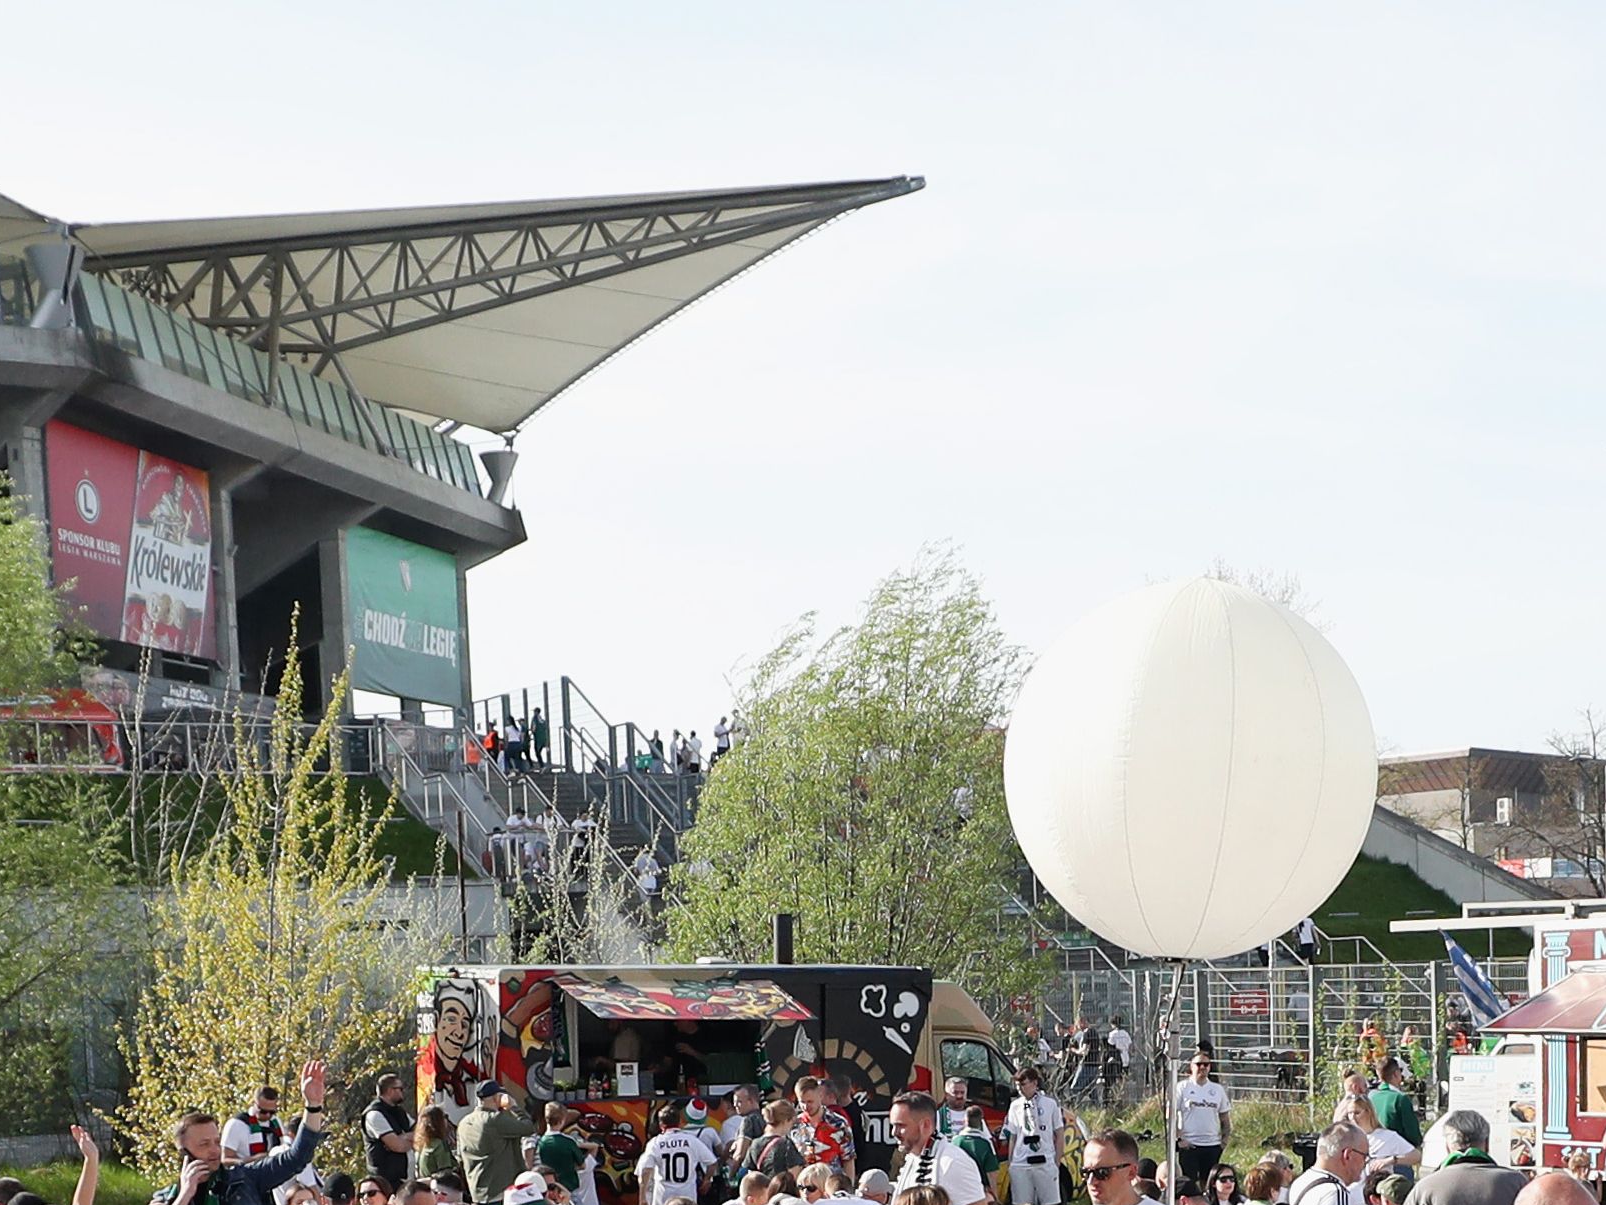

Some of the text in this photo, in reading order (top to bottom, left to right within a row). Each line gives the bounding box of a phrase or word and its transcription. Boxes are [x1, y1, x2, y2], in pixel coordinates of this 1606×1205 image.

[57, 527, 122, 556] SPONSOR KLUBU
[130, 534, 207, 592] Królewskie
[363, 609, 407, 649] CHODŹ
[659, 1139, 690, 1149] PLUTA
[661, 1151, 690, 1183] 10
